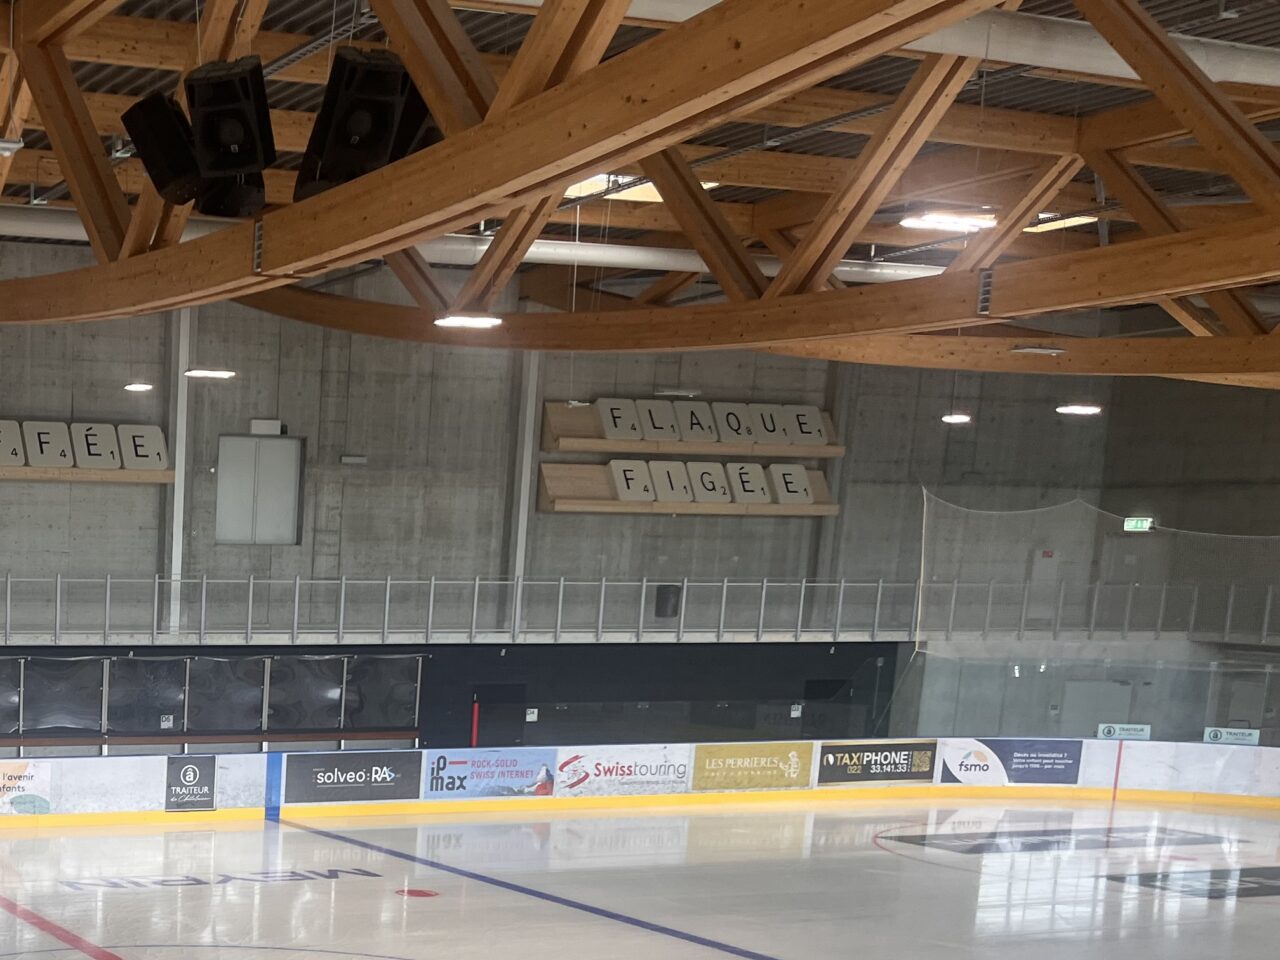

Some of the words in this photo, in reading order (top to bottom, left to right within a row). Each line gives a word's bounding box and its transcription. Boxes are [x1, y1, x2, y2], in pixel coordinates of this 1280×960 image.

[610, 407, 813, 434] FLAQUE
[622, 466, 799, 493] FIGÉE
[470, 760, 518, 769] ROCK-SOLID
[836, 751, 909, 766] TAXIPHONE
[594, 761, 687, 779] Swisstouring
[847, 765, 861, 774] 022
[870, 764, 907, 774] 33.141.33
[958, 760, 990, 773] fsmo
[2, 772, 34, 781] l'avenir
[470, 771, 495, 780] SWISS
[497, 770, 534, 779] INTERNET
[430, 775, 467, 791] max
[171, 786, 209, 794] TRAITEUR
